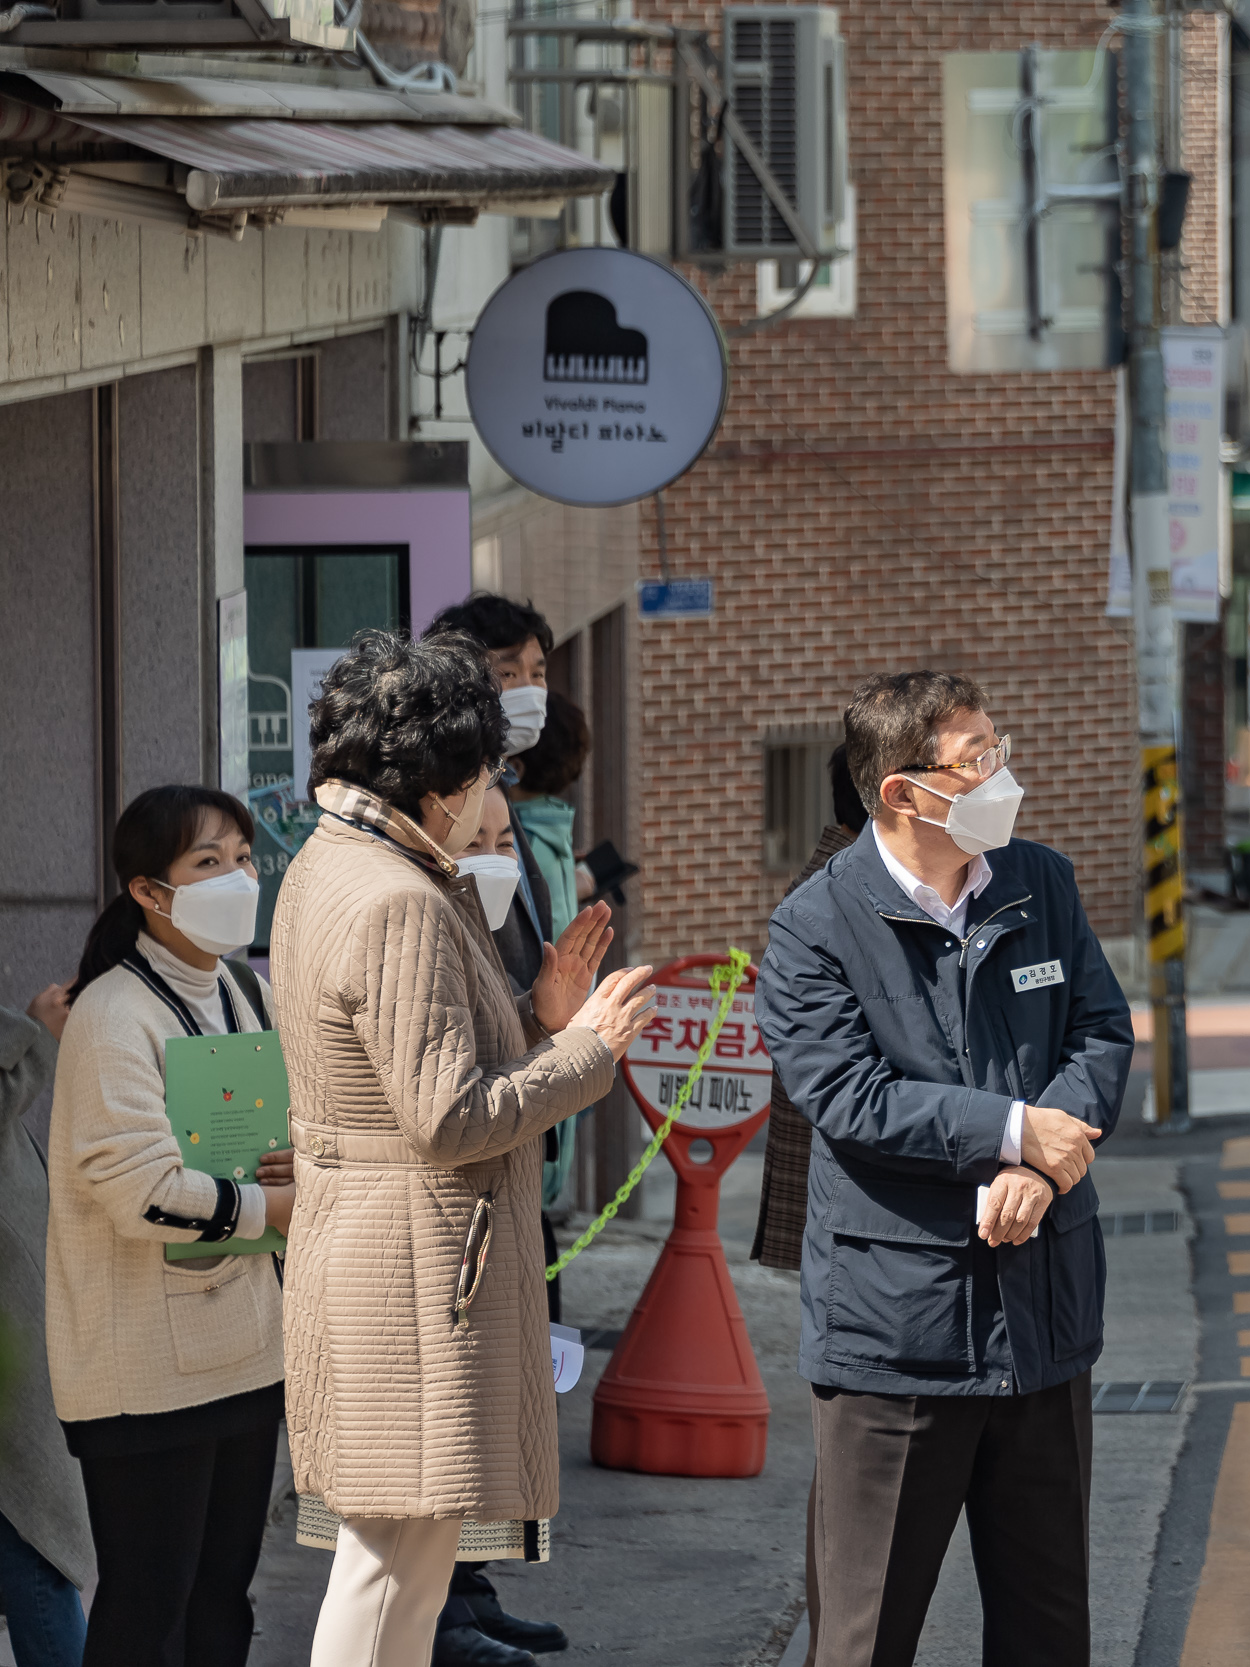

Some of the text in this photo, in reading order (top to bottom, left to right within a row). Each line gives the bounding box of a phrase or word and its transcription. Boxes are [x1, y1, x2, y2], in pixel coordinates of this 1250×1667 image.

[544, 396, 647, 414] Vivaldi Piano
[522, 417, 668, 453] 비발디 피아노
[656, 993, 682, 1009] 협조
[688, 996, 713, 1012] 부탁
[659, 1072, 753, 1115] 비발디 피아노
